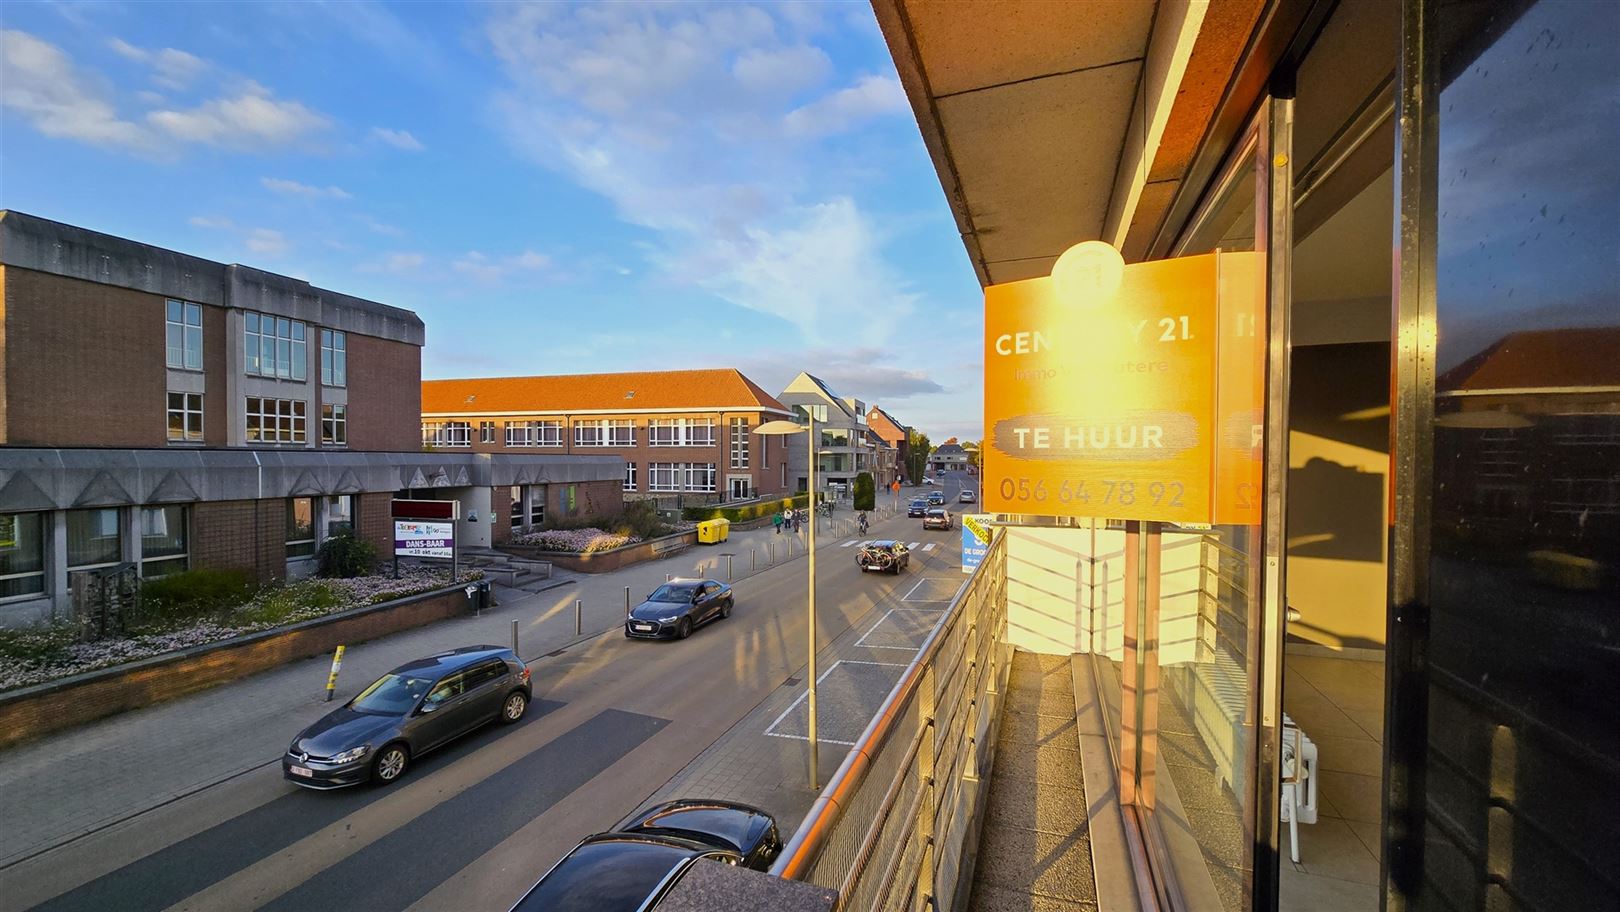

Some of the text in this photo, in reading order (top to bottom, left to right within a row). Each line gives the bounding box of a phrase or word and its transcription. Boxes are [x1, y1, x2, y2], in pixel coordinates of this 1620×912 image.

[995, 319, 1148, 356] CENY
[1013, 425, 1163, 449] TE HUUR
[1000, 478, 1186, 508] 056 64 78 92
[405, 540, 445, 548] DANS-BAAR
